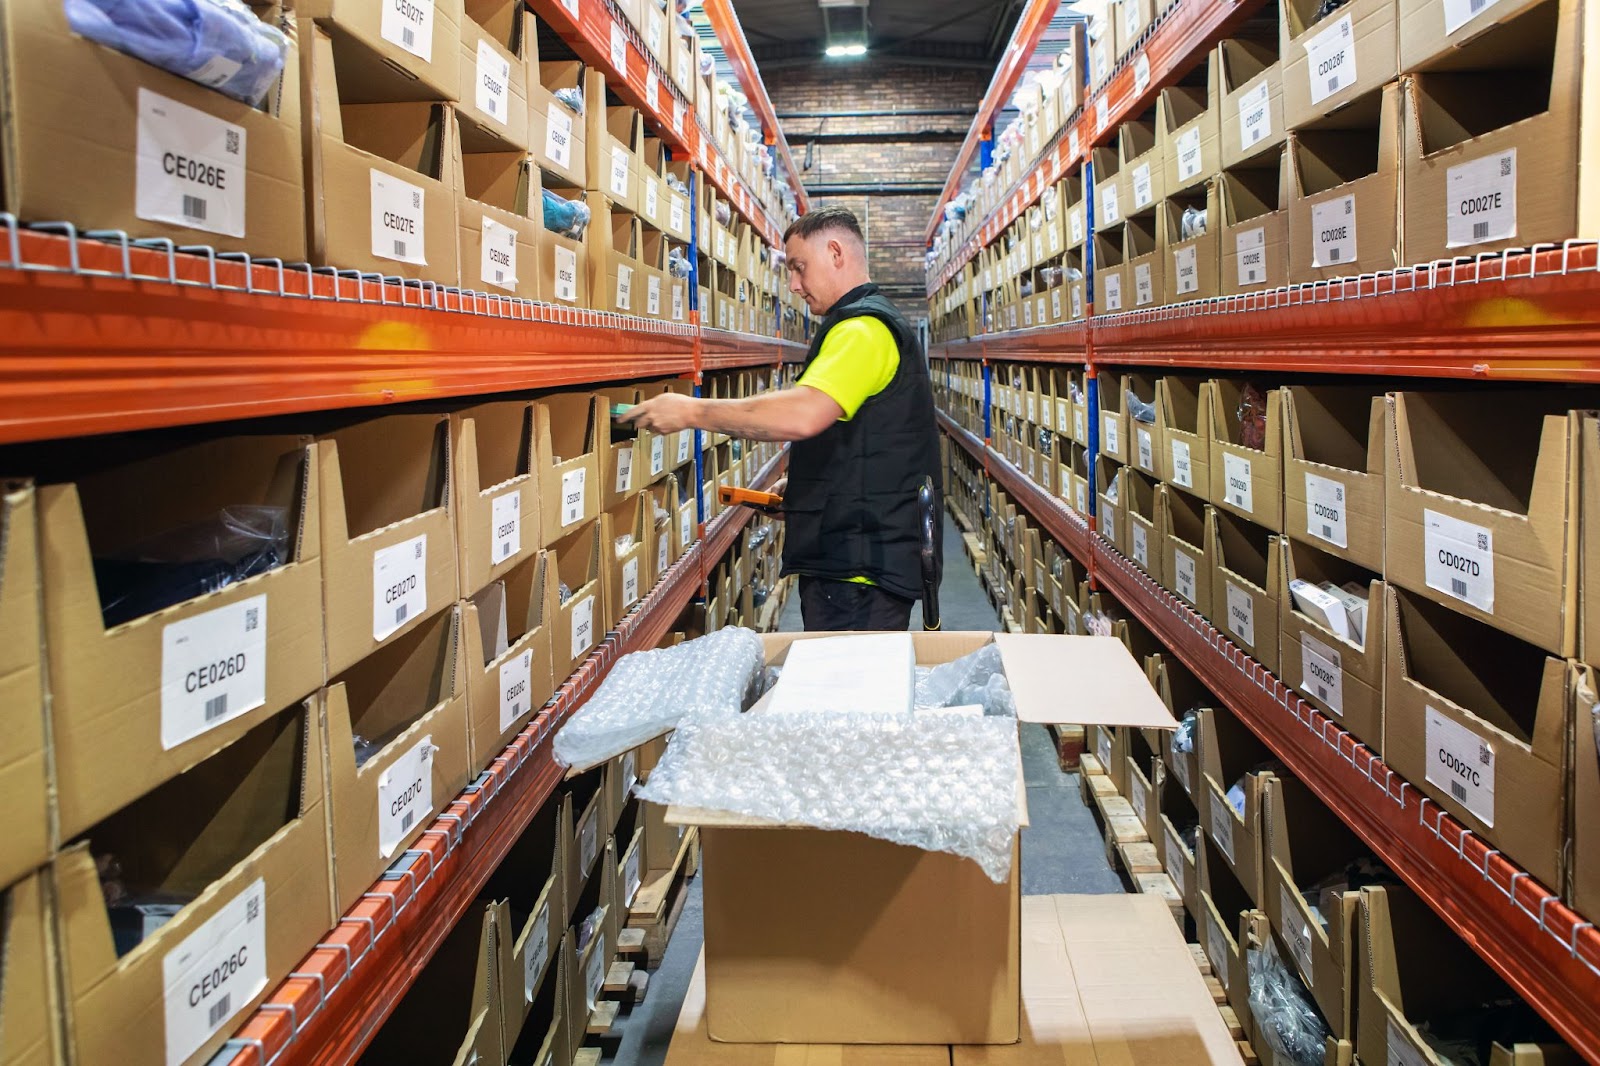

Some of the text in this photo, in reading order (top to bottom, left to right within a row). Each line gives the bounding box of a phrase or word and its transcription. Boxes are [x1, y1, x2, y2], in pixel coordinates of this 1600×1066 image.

[162, 152, 226, 190] CE026E
[1460, 192, 1502, 216] CD027E
[384, 212, 414, 234] CE027E
[1321, 226, 1346, 242] CD028E
[490, 248, 510, 266] CE028E
[1314, 503, 1338, 522] CD028D
[1438, 550, 1480, 576] CD027D
[386, 574, 416, 604] CE027D
[185, 653, 246, 693] CE026D
[1310, 662, 1334, 688] CD028C
[1439, 748, 1480, 787] CD027C
[391, 778, 422, 817] CE027C
[189, 946, 248, 1007] CE026C
